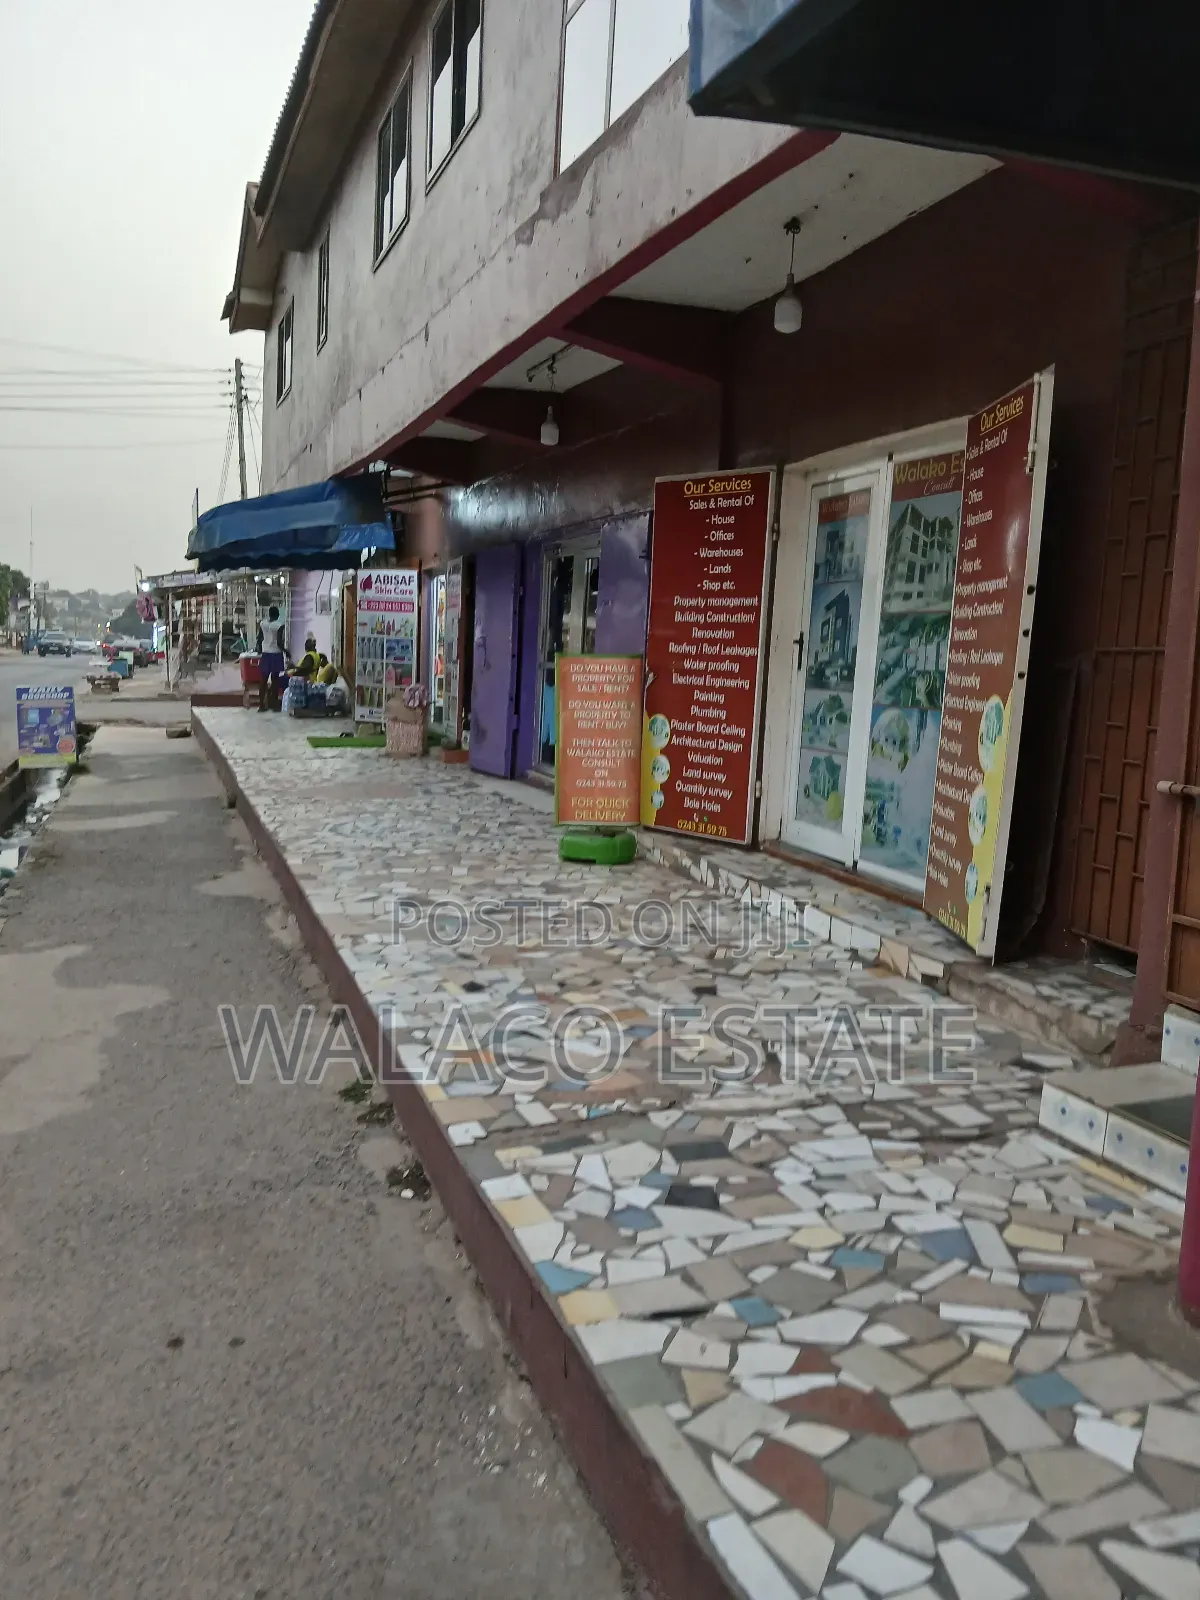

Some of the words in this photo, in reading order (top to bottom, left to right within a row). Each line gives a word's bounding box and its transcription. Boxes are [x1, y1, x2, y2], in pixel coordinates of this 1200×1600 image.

[980, 412, 994, 432] Our
[995, 396, 1024, 423] Services
[985, 432, 1000, 452] Rental
[1001, 427, 1009, 444] Of
[895, 459, 946, 485] Walako
[970, 465, 984, 480] House
[684, 481, 705, 495] Our
[708, 478, 752, 493] Services
[924, 477, 955, 496] Consult
[689, 499, 708, 510] Sales
[709, 498, 716, 508] &
[717, 495, 743, 508] Rental
[744, 495, 755, 506] Of
[968, 490, 983, 505] Offices
[711, 514, 735, 525] House
[966, 509, 993, 528] Warehouses
[710, 531, 735, 542] Offices
[699, 547, 744, 558] Warehouses
[709, 563, 732, 574] Lands
[374, 574, 414, 586] ABISAF
[702, 579, 721, 591] Shop
[722, 580, 736, 590] etc.
[976, 576, 1008, 594] management
[375, 586, 392, 595] Skin
[394, 586, 413, 596] Care
[674, 595, 706, 608] Property
[707, 595, 759, 607] management
[674, 611, 705, 624] Building
[692, 626, 735, 639] Renovation
[668, 642, 697, 655] Roofing
[702, 643, 722, 654] Roof
[570, 664, 584, 673] DO
[584, 664, 603, 673] YOU
[604, 664, 629, 673] HAVE
[684, 660, 707, 671] Water
[708, 660, 740, 673] proofing
[571, 674, 616, 684] PROPERTY
[672, 673, 704, 686] Electrical
[706, 675, 750, 690] Engineering
[577, 684, 597, 693] SALE
[693, 690, 725, 704] Painting
[568, 701, 582, 709] DO
[573, 710, 618, 720] PROPERTY
[620, 711, 631, 719] TO
[690, 705, 727, 720] Plumbing
[577, 720, 599, 730] RENT
[670, 718, 696, 731] Plaster
[697, 720, 719, 734] Board
[720, 724, 746, 738] Ceiling
[571, 738, 595, 747] THEN
[670, 734, 717, 749] Architectural
[717, 739, 743, 753] Design
[581, 759, 621, 768] CONSULT
[687, 751, 723, 766] Valuation
[594, 770, 608, 778] ON
[683, 766, 702, 779] Land
[702, 770, 727, 784] survey
[675, 780, 708, 796] Quantity
[708, 787, 733, 801] survey
[571, 797, 593, 807] FOR
[595, 798, 631, 809] QUICK
[701, 800, 721, 812] Holes
[574, 810, 627, 821] DELIVERY
[677, 819, 696, 831] 0243
